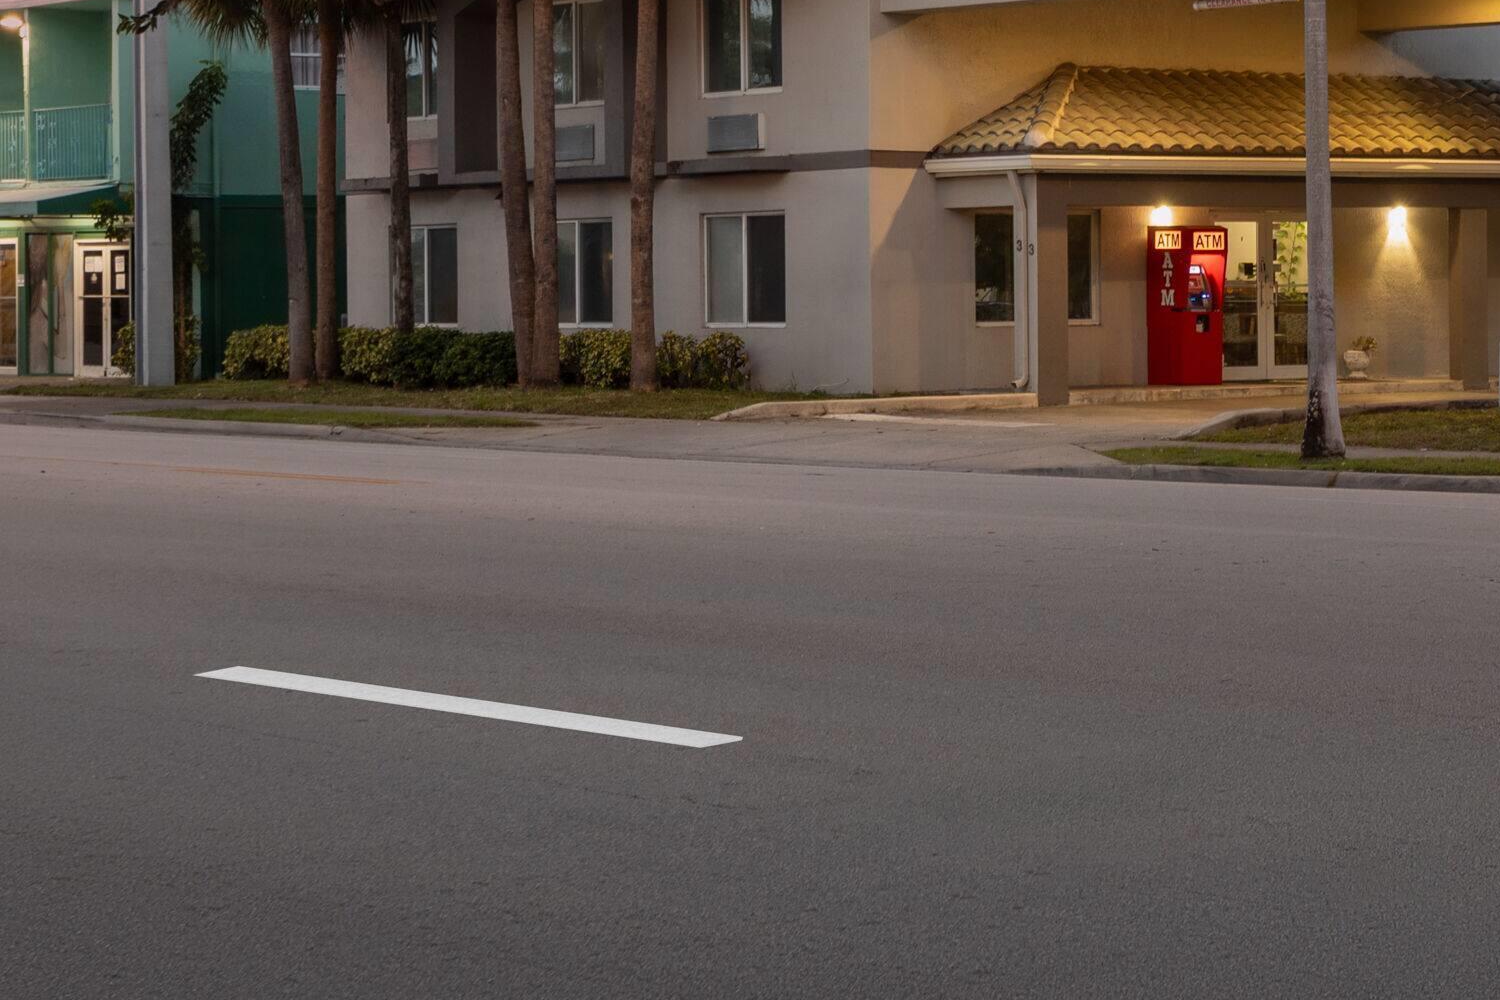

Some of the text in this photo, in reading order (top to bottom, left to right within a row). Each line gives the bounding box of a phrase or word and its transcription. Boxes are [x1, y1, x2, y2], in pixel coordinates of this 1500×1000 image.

[1157, 233, 1180, 248] ATM
[1196, 234, 1222, 249] ATM
[1161, 251, 1175, 306] ATM
